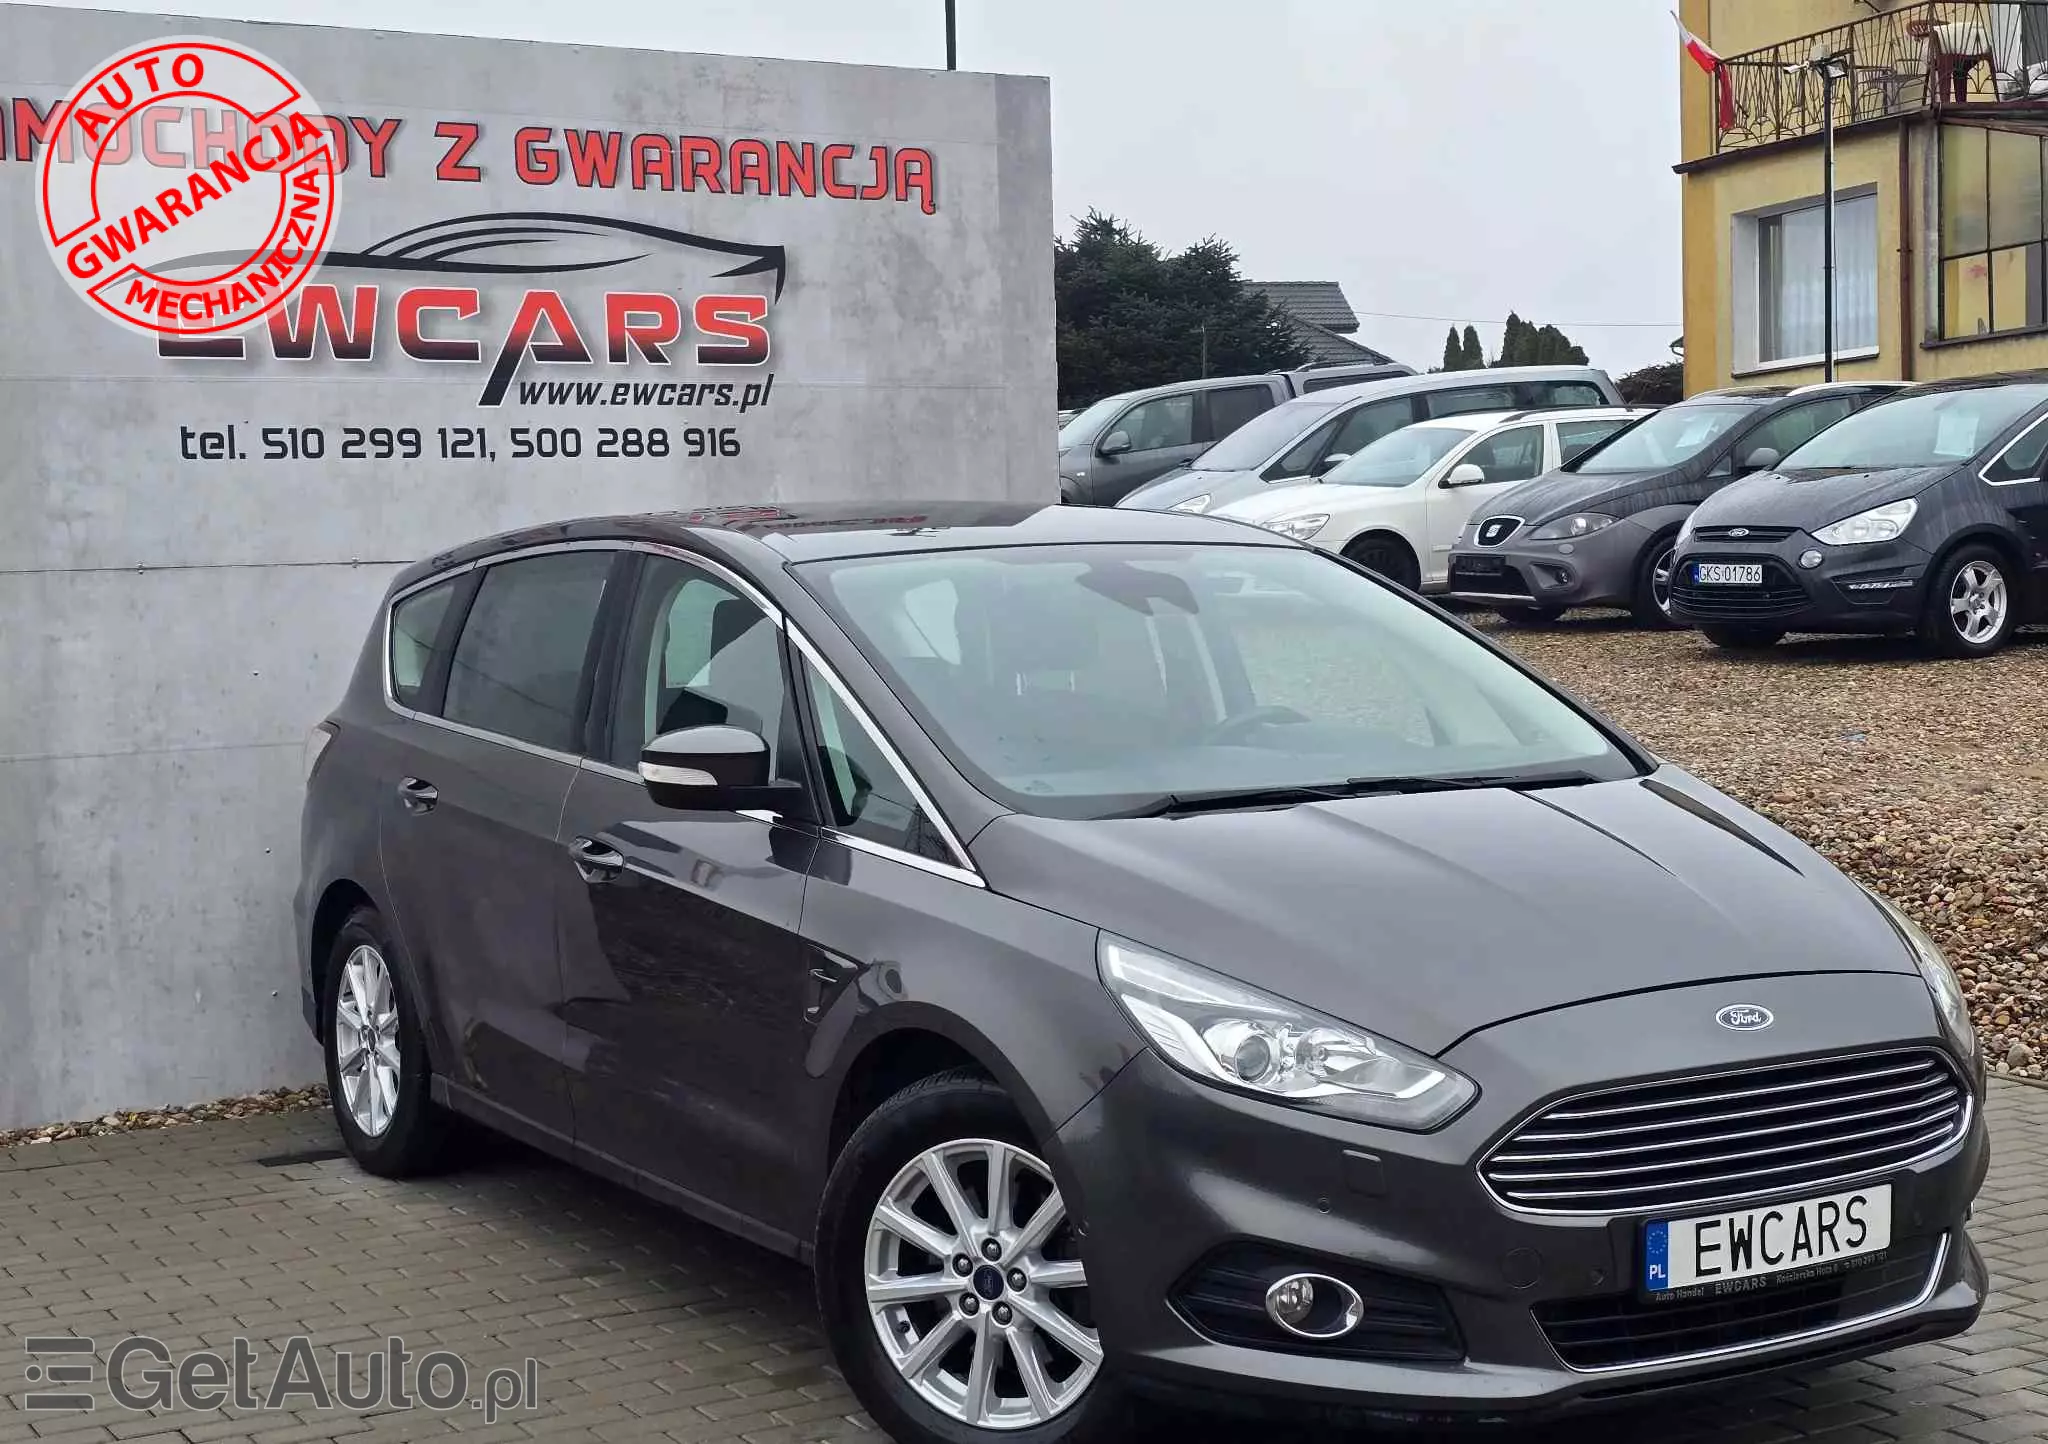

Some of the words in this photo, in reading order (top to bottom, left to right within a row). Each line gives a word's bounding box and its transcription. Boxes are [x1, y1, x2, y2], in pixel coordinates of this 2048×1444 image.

[0, 97, 403, 178] MOCHODY
[434, 121, 482, 183] Z
[514, 126, 936, 215] GWARANCJĄ
[156, 281, 770, 407] EWCARS
[519, 374, 774, 413] www.ewcars.pl
[180, 424, 247, 460] tel.
[262, 427, 326, 460] 510
[341, 427, 422, 459] 299
[437, 427, 496, 462] 121,
[510, 427, 582, 459] 500
[596, 427, 670, 459] 288
[683, 427, 741, 459] 916
[1730, 1009, 1762, 1025] Ford
[1695, 1195, 1868, 1278] EWCARS
[1649, 1263, 1666, 1280] PL
[1715, 1277, 1767, 1296] EWCARS
